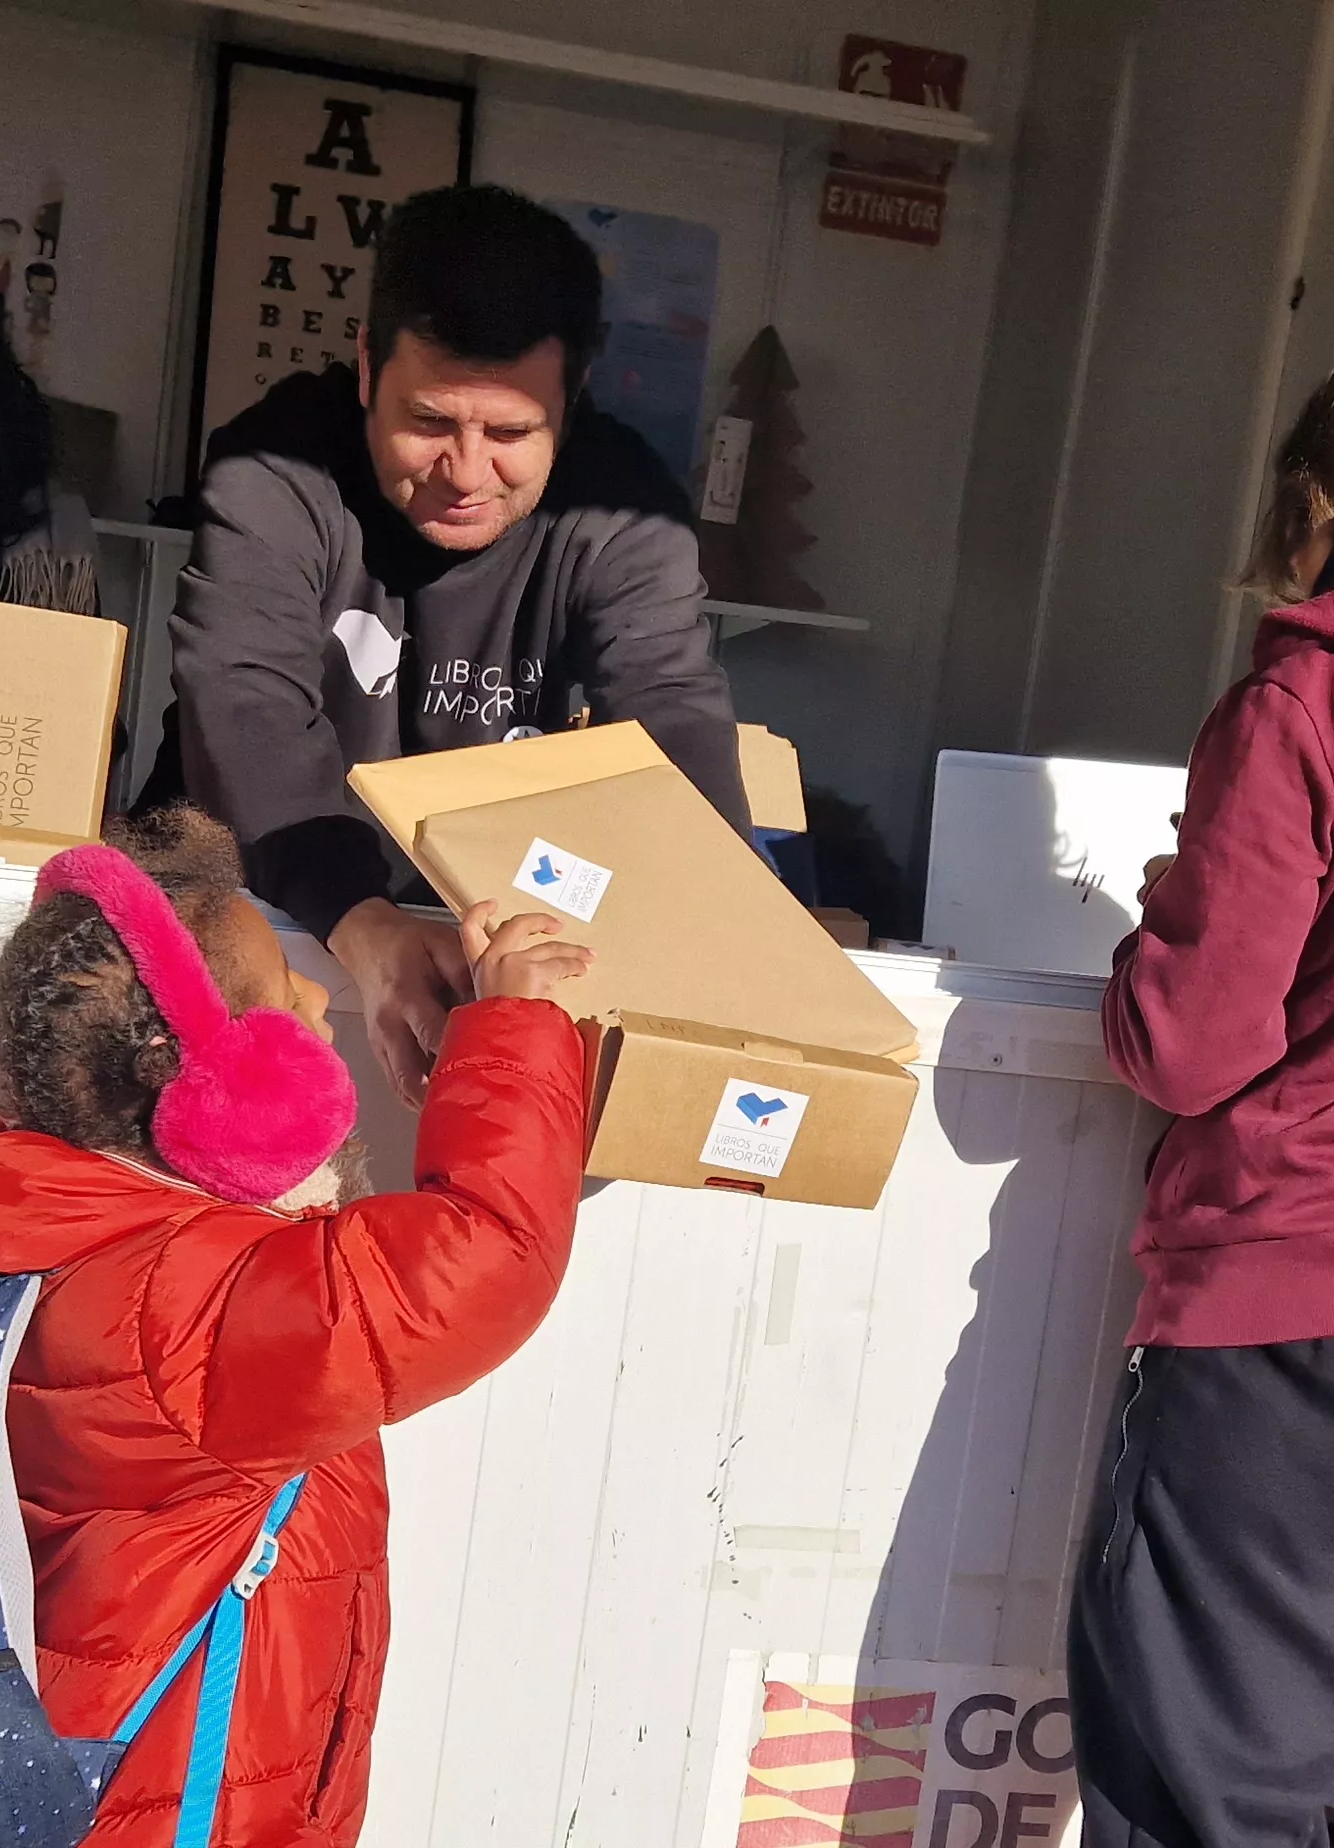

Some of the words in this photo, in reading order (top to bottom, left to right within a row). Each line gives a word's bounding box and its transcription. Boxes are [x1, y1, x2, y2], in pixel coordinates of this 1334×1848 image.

[304, 98, 382, 176] A
[826, 185, 939, 232] EXTINTOR
[429, 658, 503, 691] LIBRO
[423, 686, 541, 726] IMPORT
[8, 716, 44, 827] MPORTAN
[710, 1144, 778, 1169] IMPORTAN
[715, 1134, 752, 1150] LIBROS
[757, 1143, 782, 1156] QUE
[944, 1693, 1075, 1774] GO
